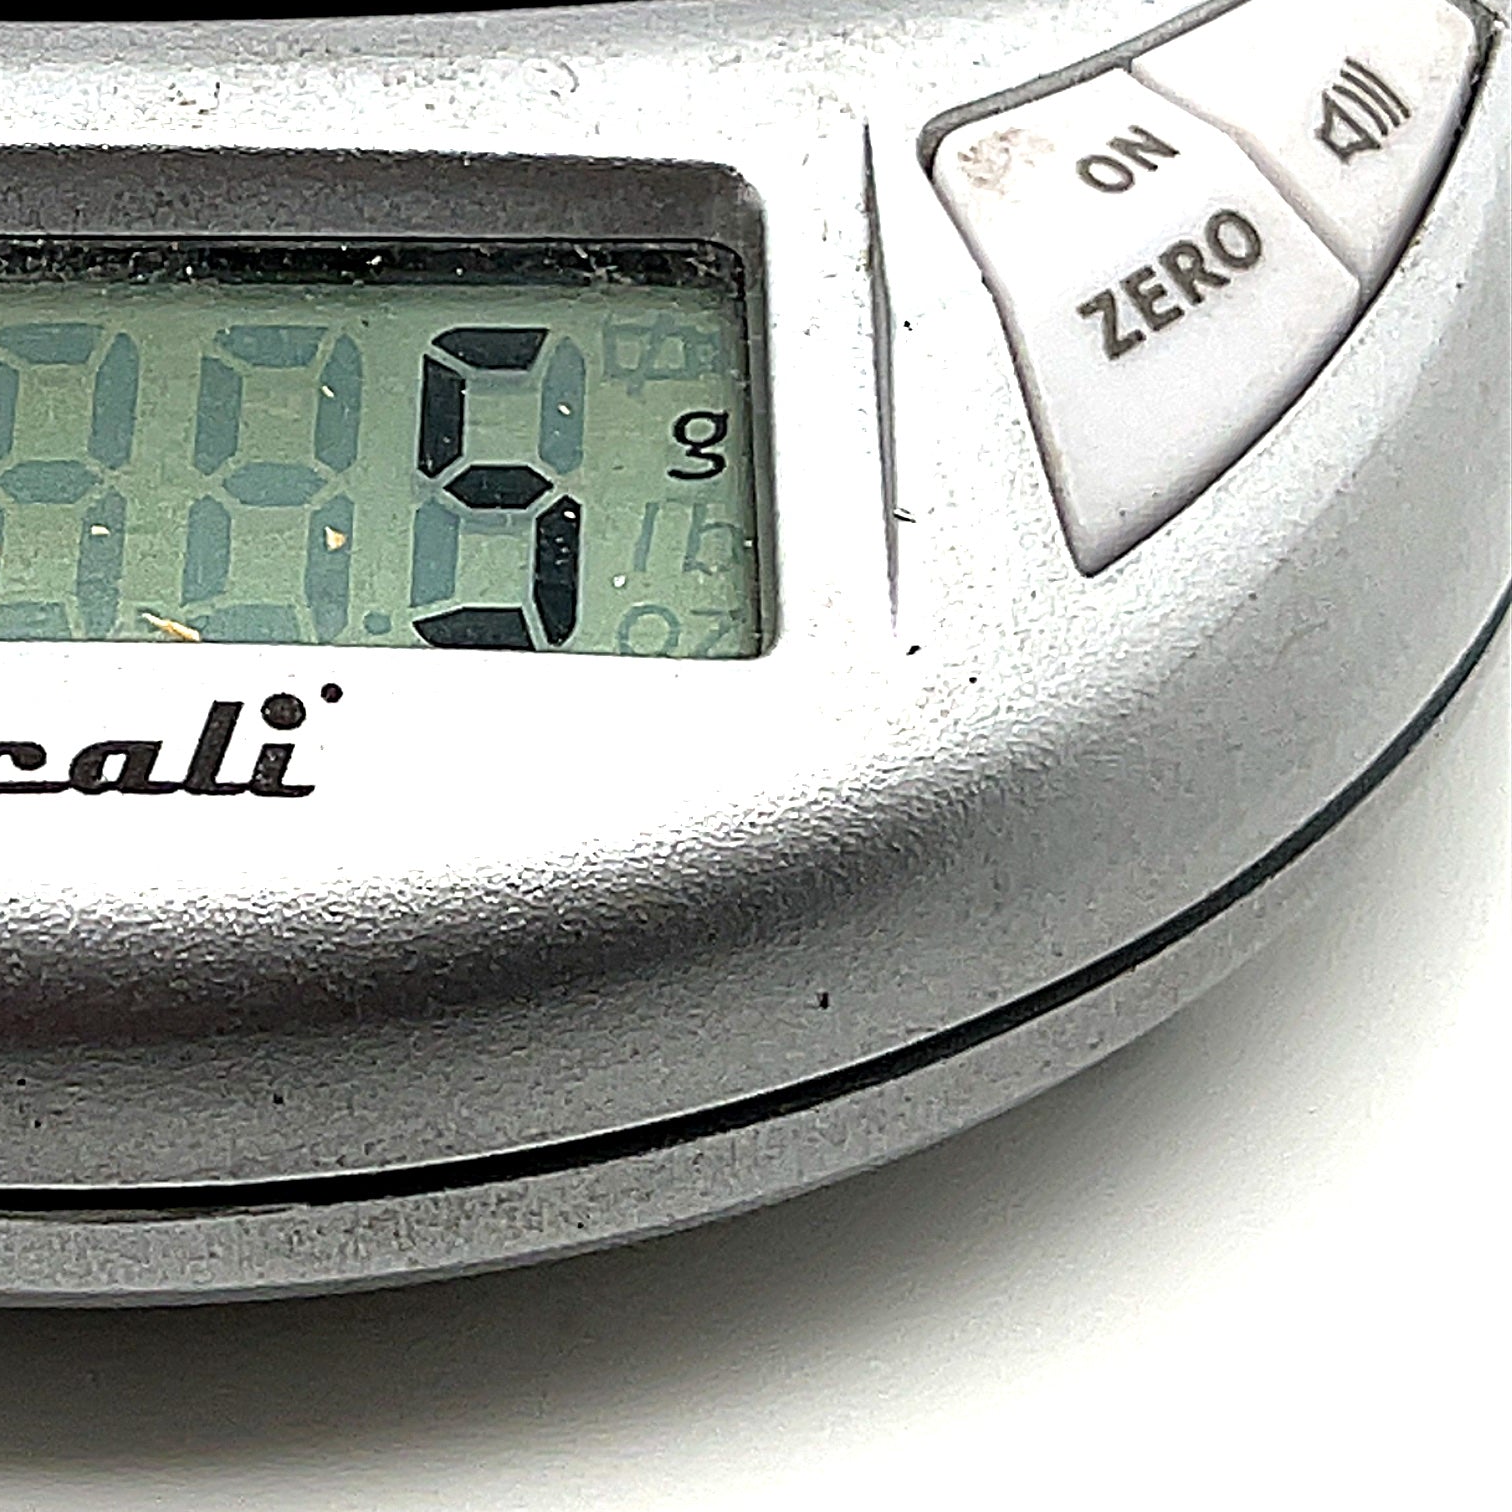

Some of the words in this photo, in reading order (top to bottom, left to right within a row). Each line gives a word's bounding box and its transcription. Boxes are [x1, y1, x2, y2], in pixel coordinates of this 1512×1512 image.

[1076, 124, 1180, 194] ON
[1076, 208, 1262, 360] ZERO
[666, 409, 730, 482] g
